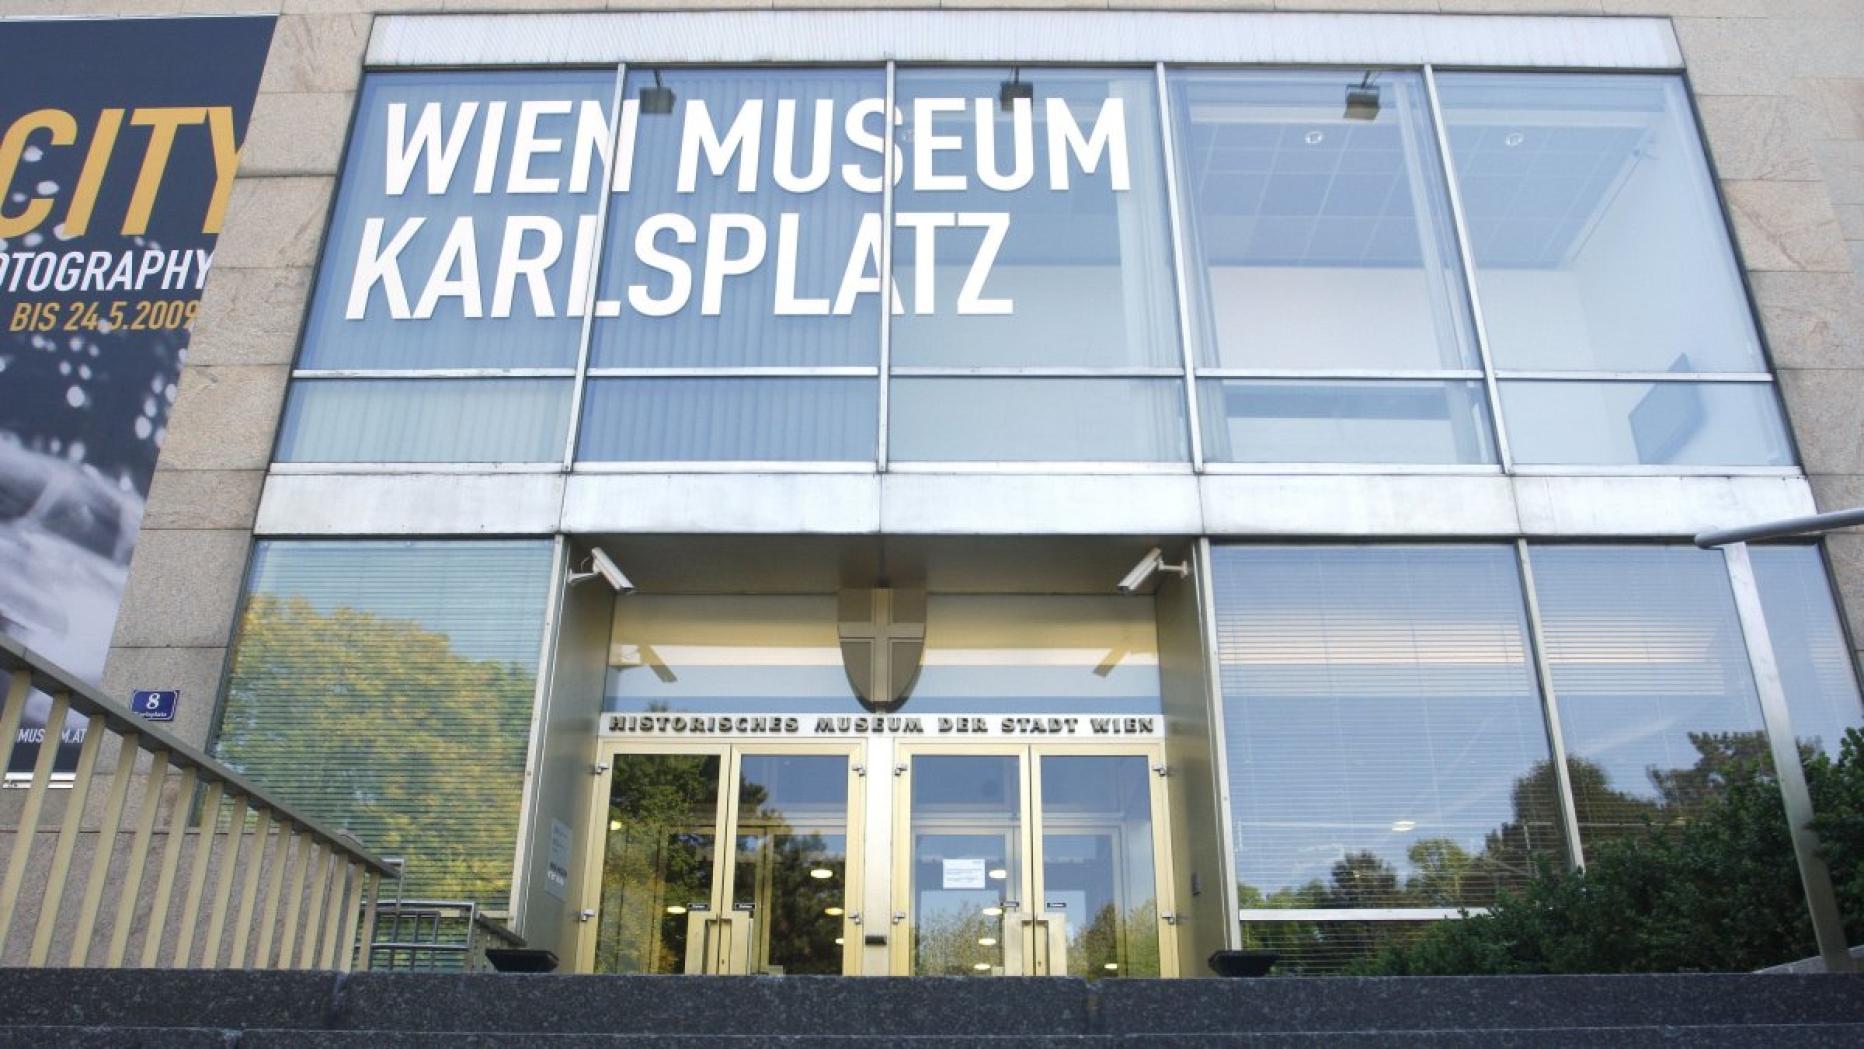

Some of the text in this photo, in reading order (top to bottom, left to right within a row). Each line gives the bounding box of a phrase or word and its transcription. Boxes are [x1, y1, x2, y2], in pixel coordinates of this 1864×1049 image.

[0, 106, 245, 238] CITY
[385, 97, 1132, 195] WIEN MUSEUM
[344, 212, 1014, 319] KARLSPLATZ
[9, 302, 60, 332] BIS
[146, 692, 160, 710] 8
[608, 716, 1154, 734] HISTORISCHES MUSEUM DER STADT WIEN
